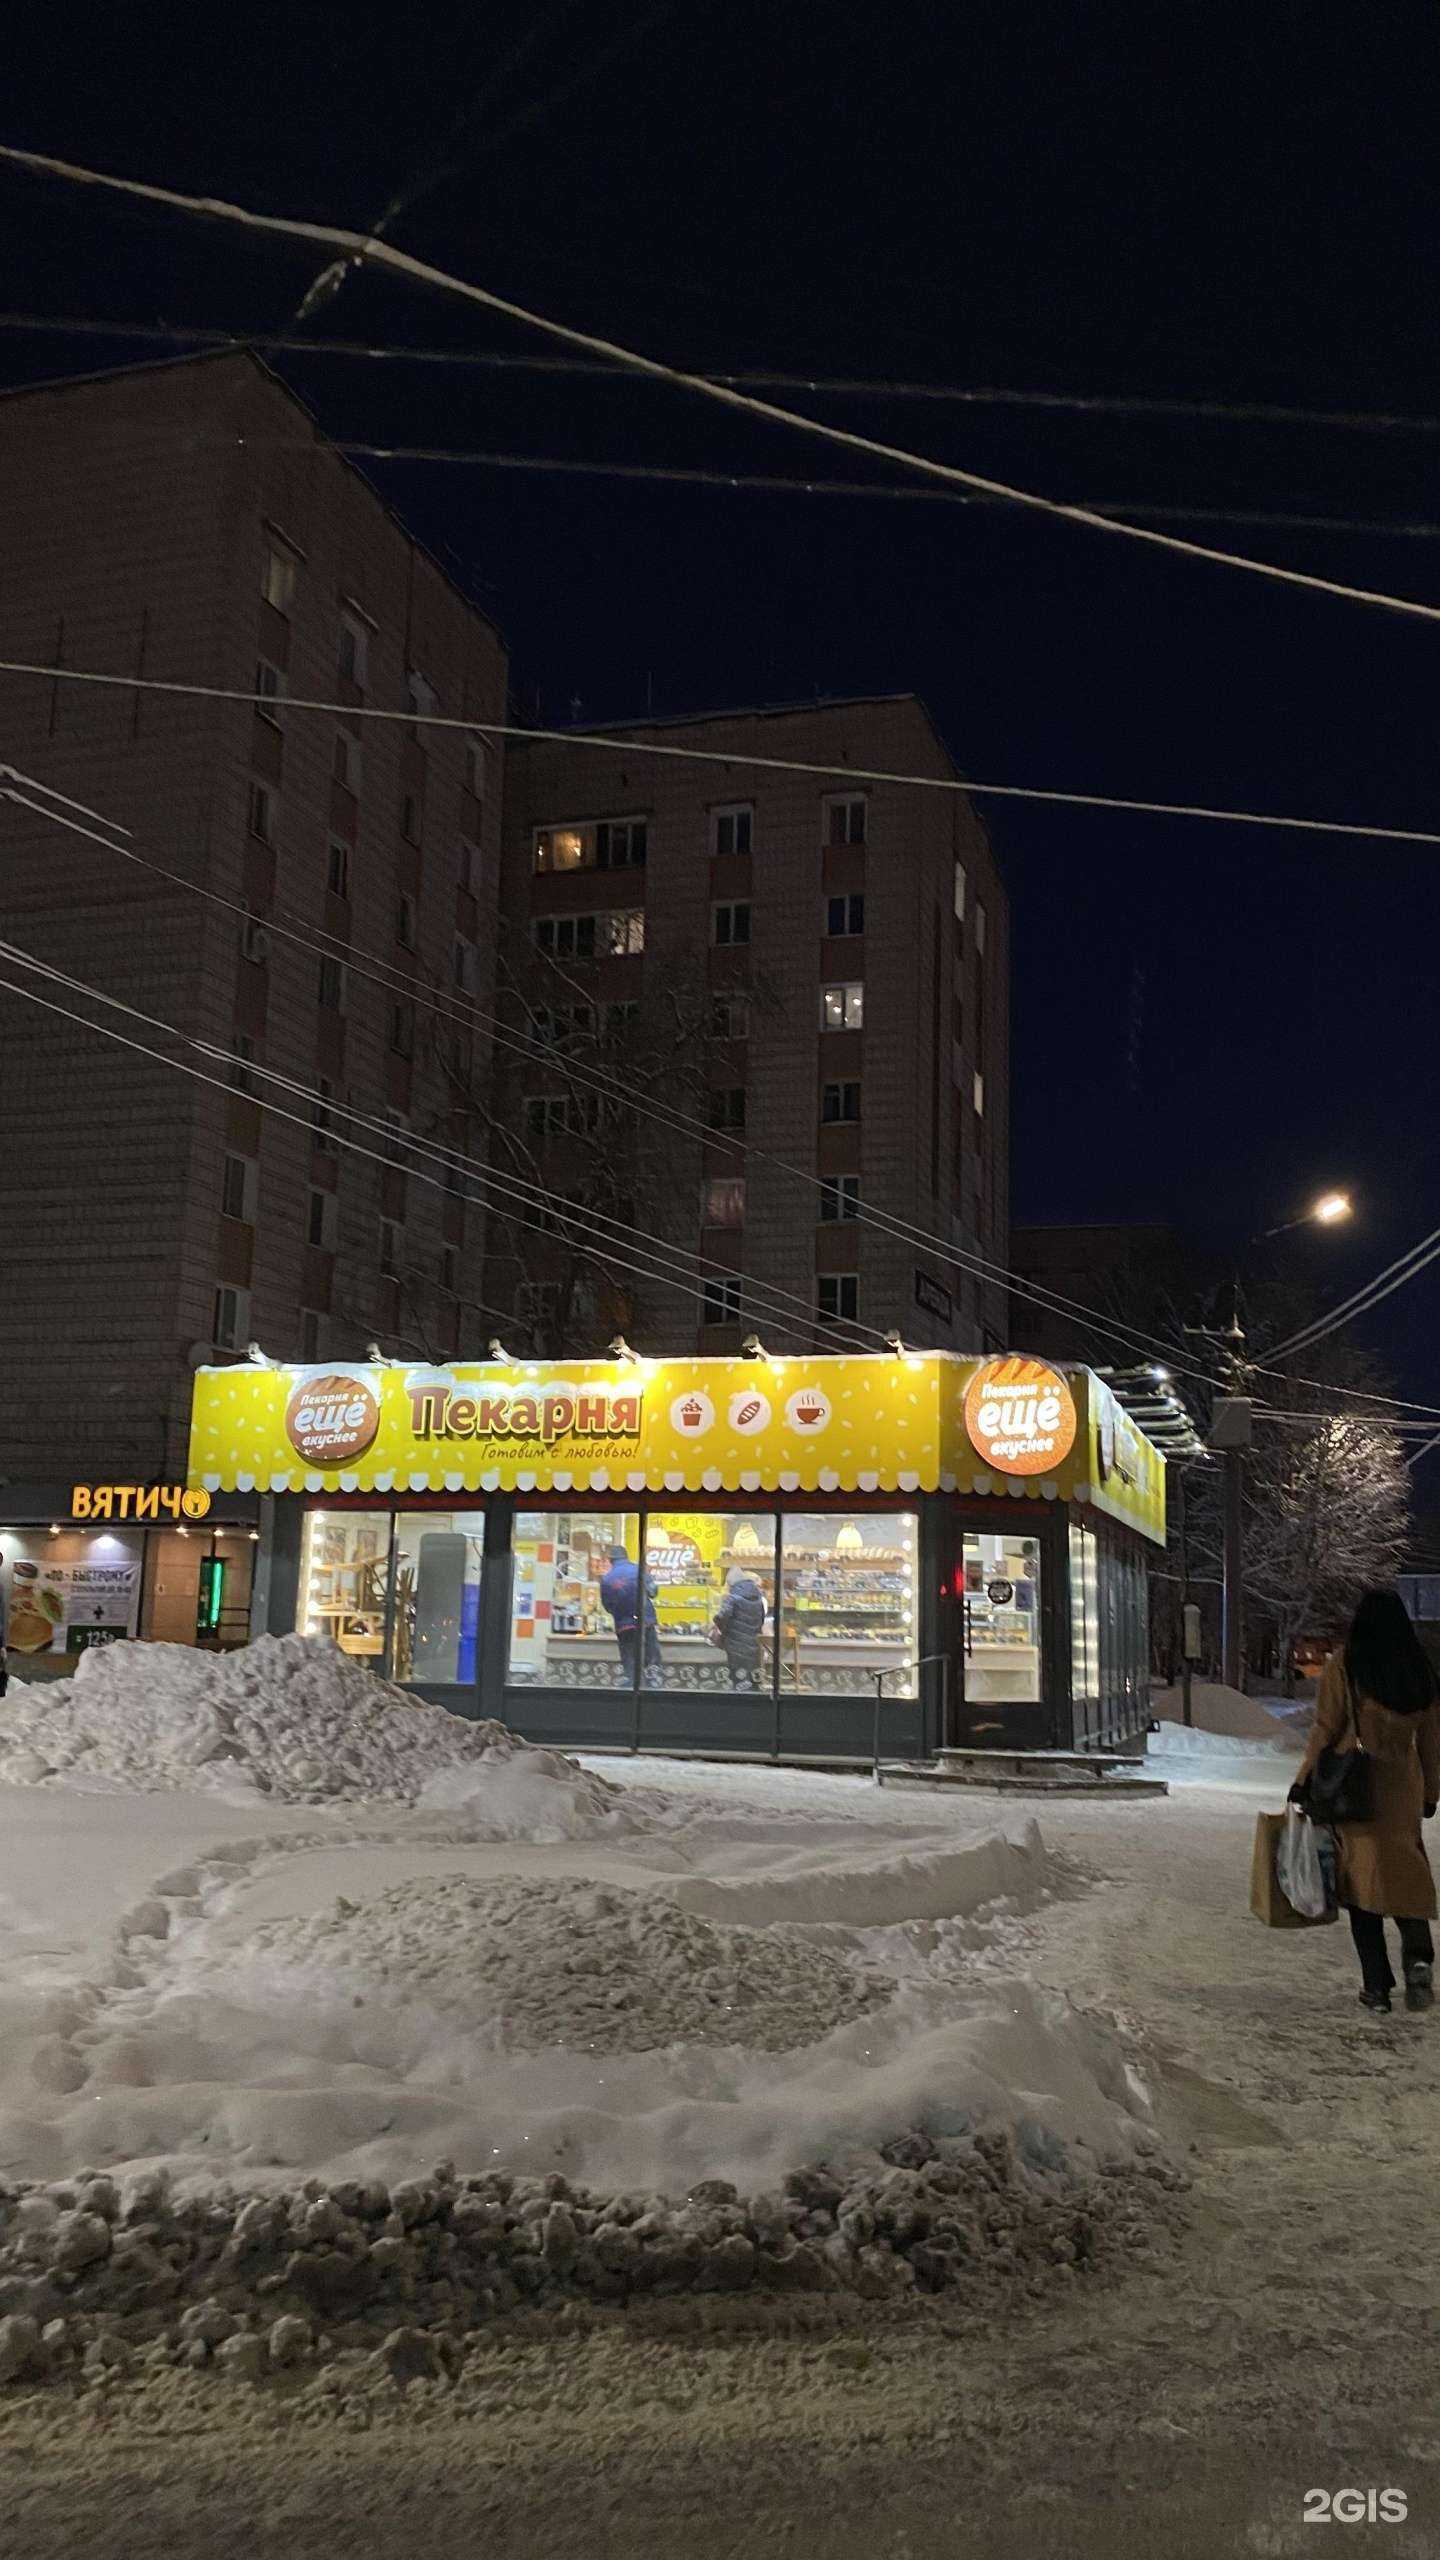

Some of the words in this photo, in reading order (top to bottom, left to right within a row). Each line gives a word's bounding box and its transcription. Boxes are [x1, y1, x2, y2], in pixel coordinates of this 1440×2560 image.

[301, 1393, 349, 1406] Пекарня
[981, 1383, 1038, 1400] Пекарня
[295, 1393, 368, 1433] ещё
[405, 1385, 642, 1442] Пекарня
[978, 1386, 1060, 1439] ещё
[302, 1432, 358, 1449] вкуснее
[481, 1441, 545, 1460] Готовим
[565, 1442, 640, 1459] любовью!
[990, 1438, 1054, 1460] вкуснее
[72, 1486, 182, 1519] ВЯТИЧ
